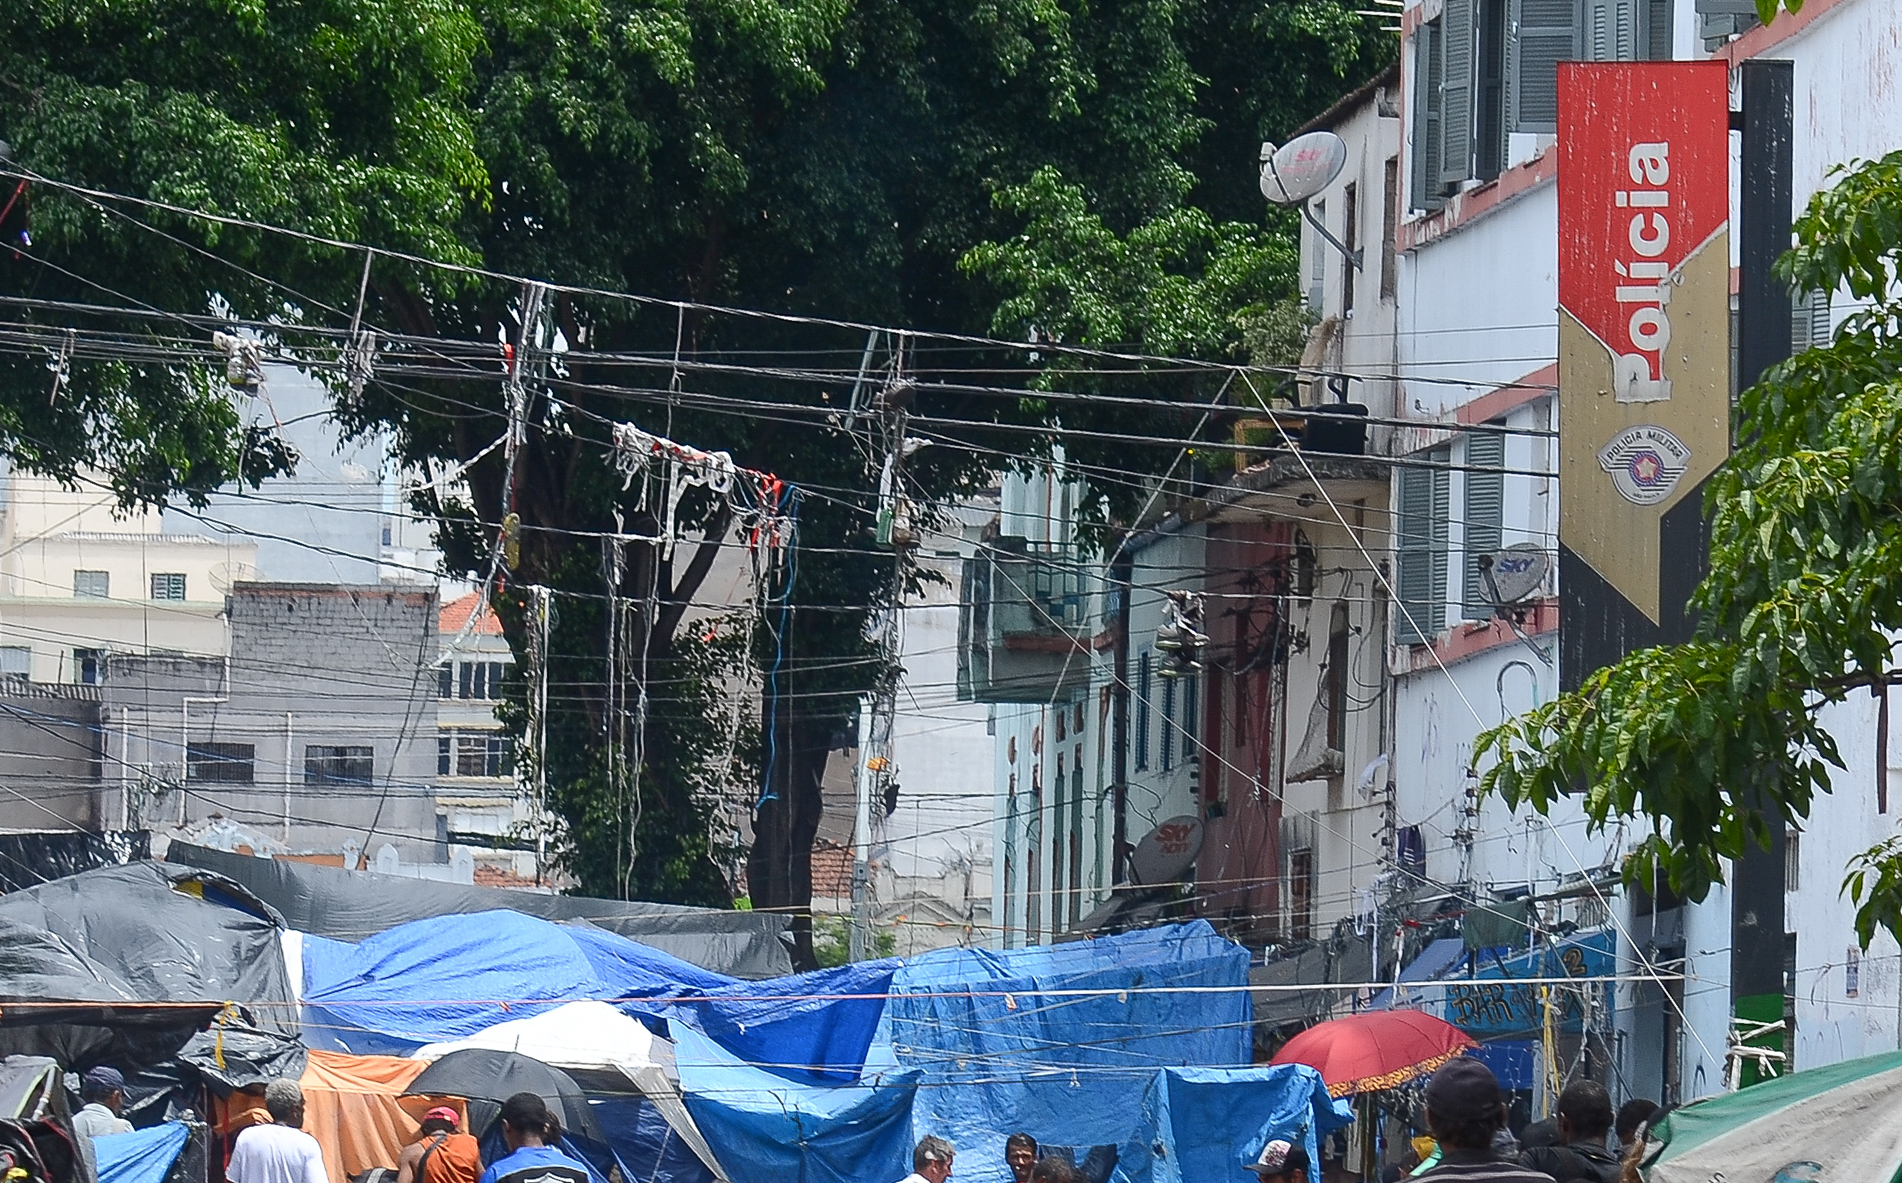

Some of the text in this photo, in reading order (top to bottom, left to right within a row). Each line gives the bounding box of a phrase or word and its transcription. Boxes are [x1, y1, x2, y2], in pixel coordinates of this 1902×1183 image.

[1614, 141, 1672, 403] Polícia
[1496, 557, 1536, 573] SKY
[1154, 824, 1197, 841] SKY
[1562, 947, 1588, 975] 2
